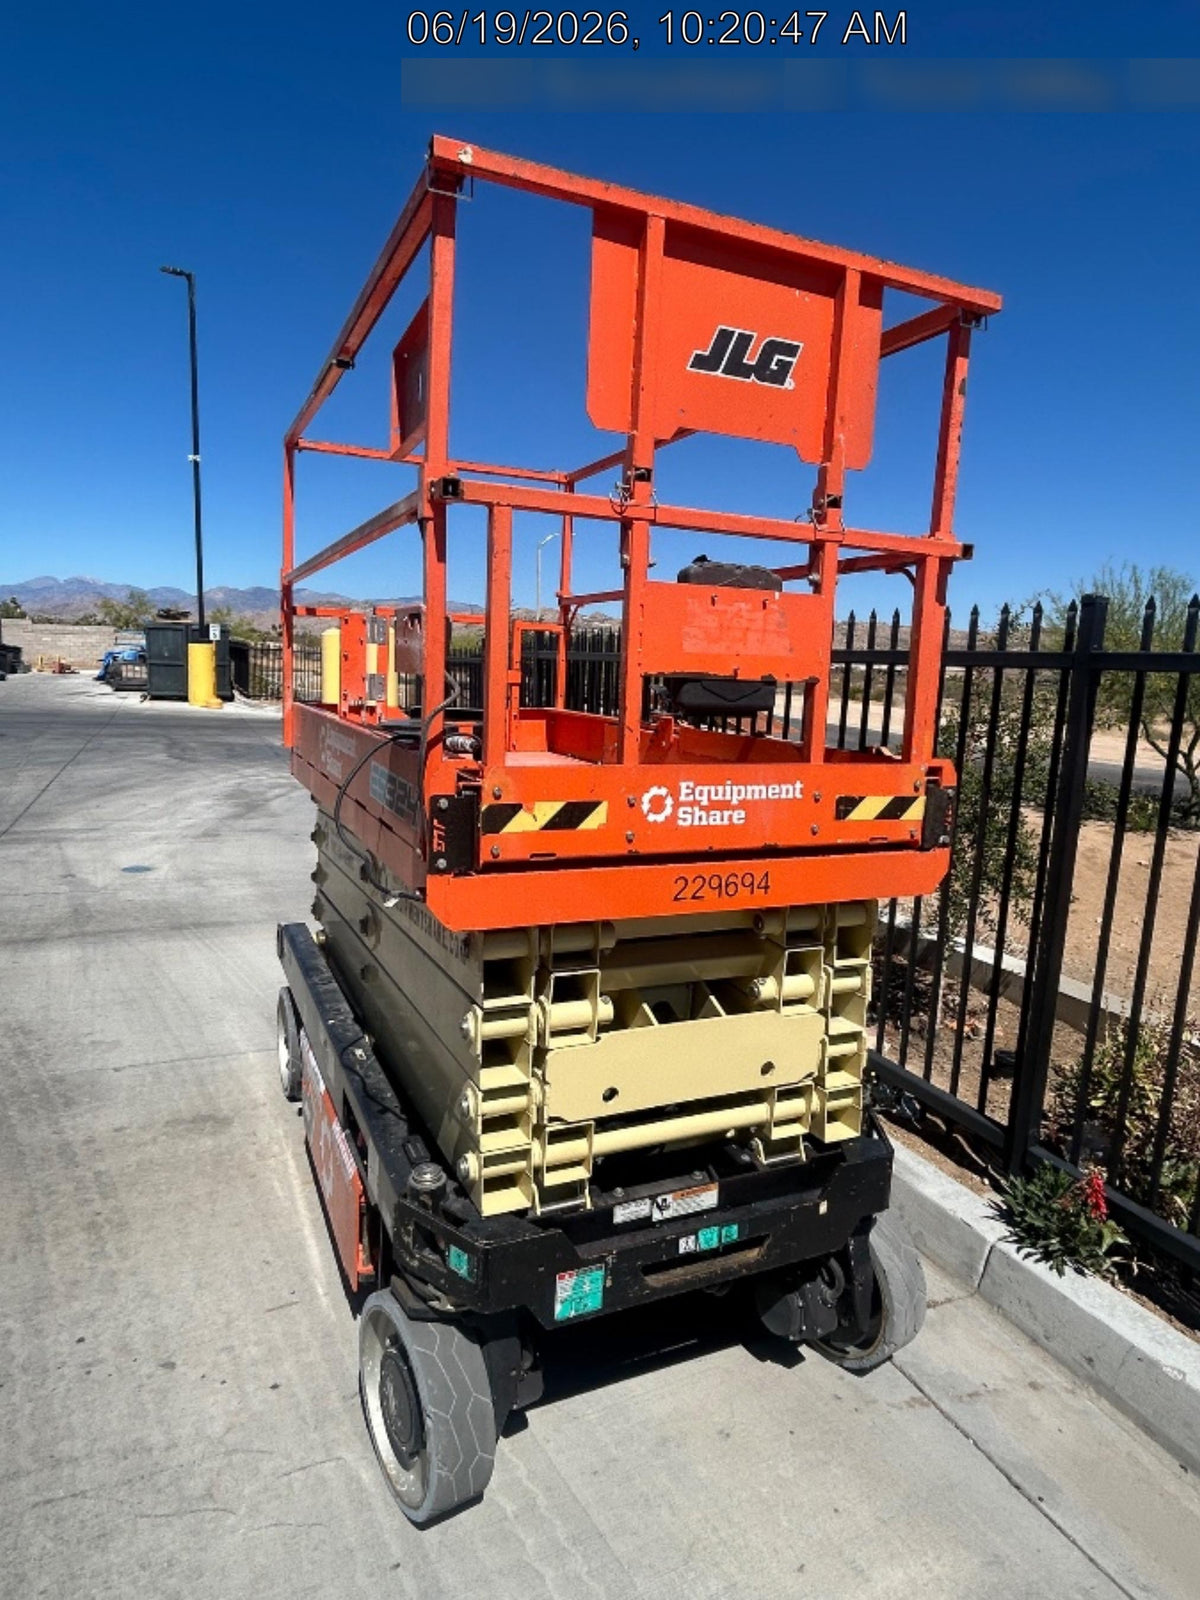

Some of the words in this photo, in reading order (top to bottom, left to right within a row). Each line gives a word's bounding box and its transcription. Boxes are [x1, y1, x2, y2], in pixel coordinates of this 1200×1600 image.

[686, 325, 804, 389] JLG
[678, 780, 804, 806] Equipment
[677, 806, 746, 826] Share
[673, 871, 771, 901] 229694
